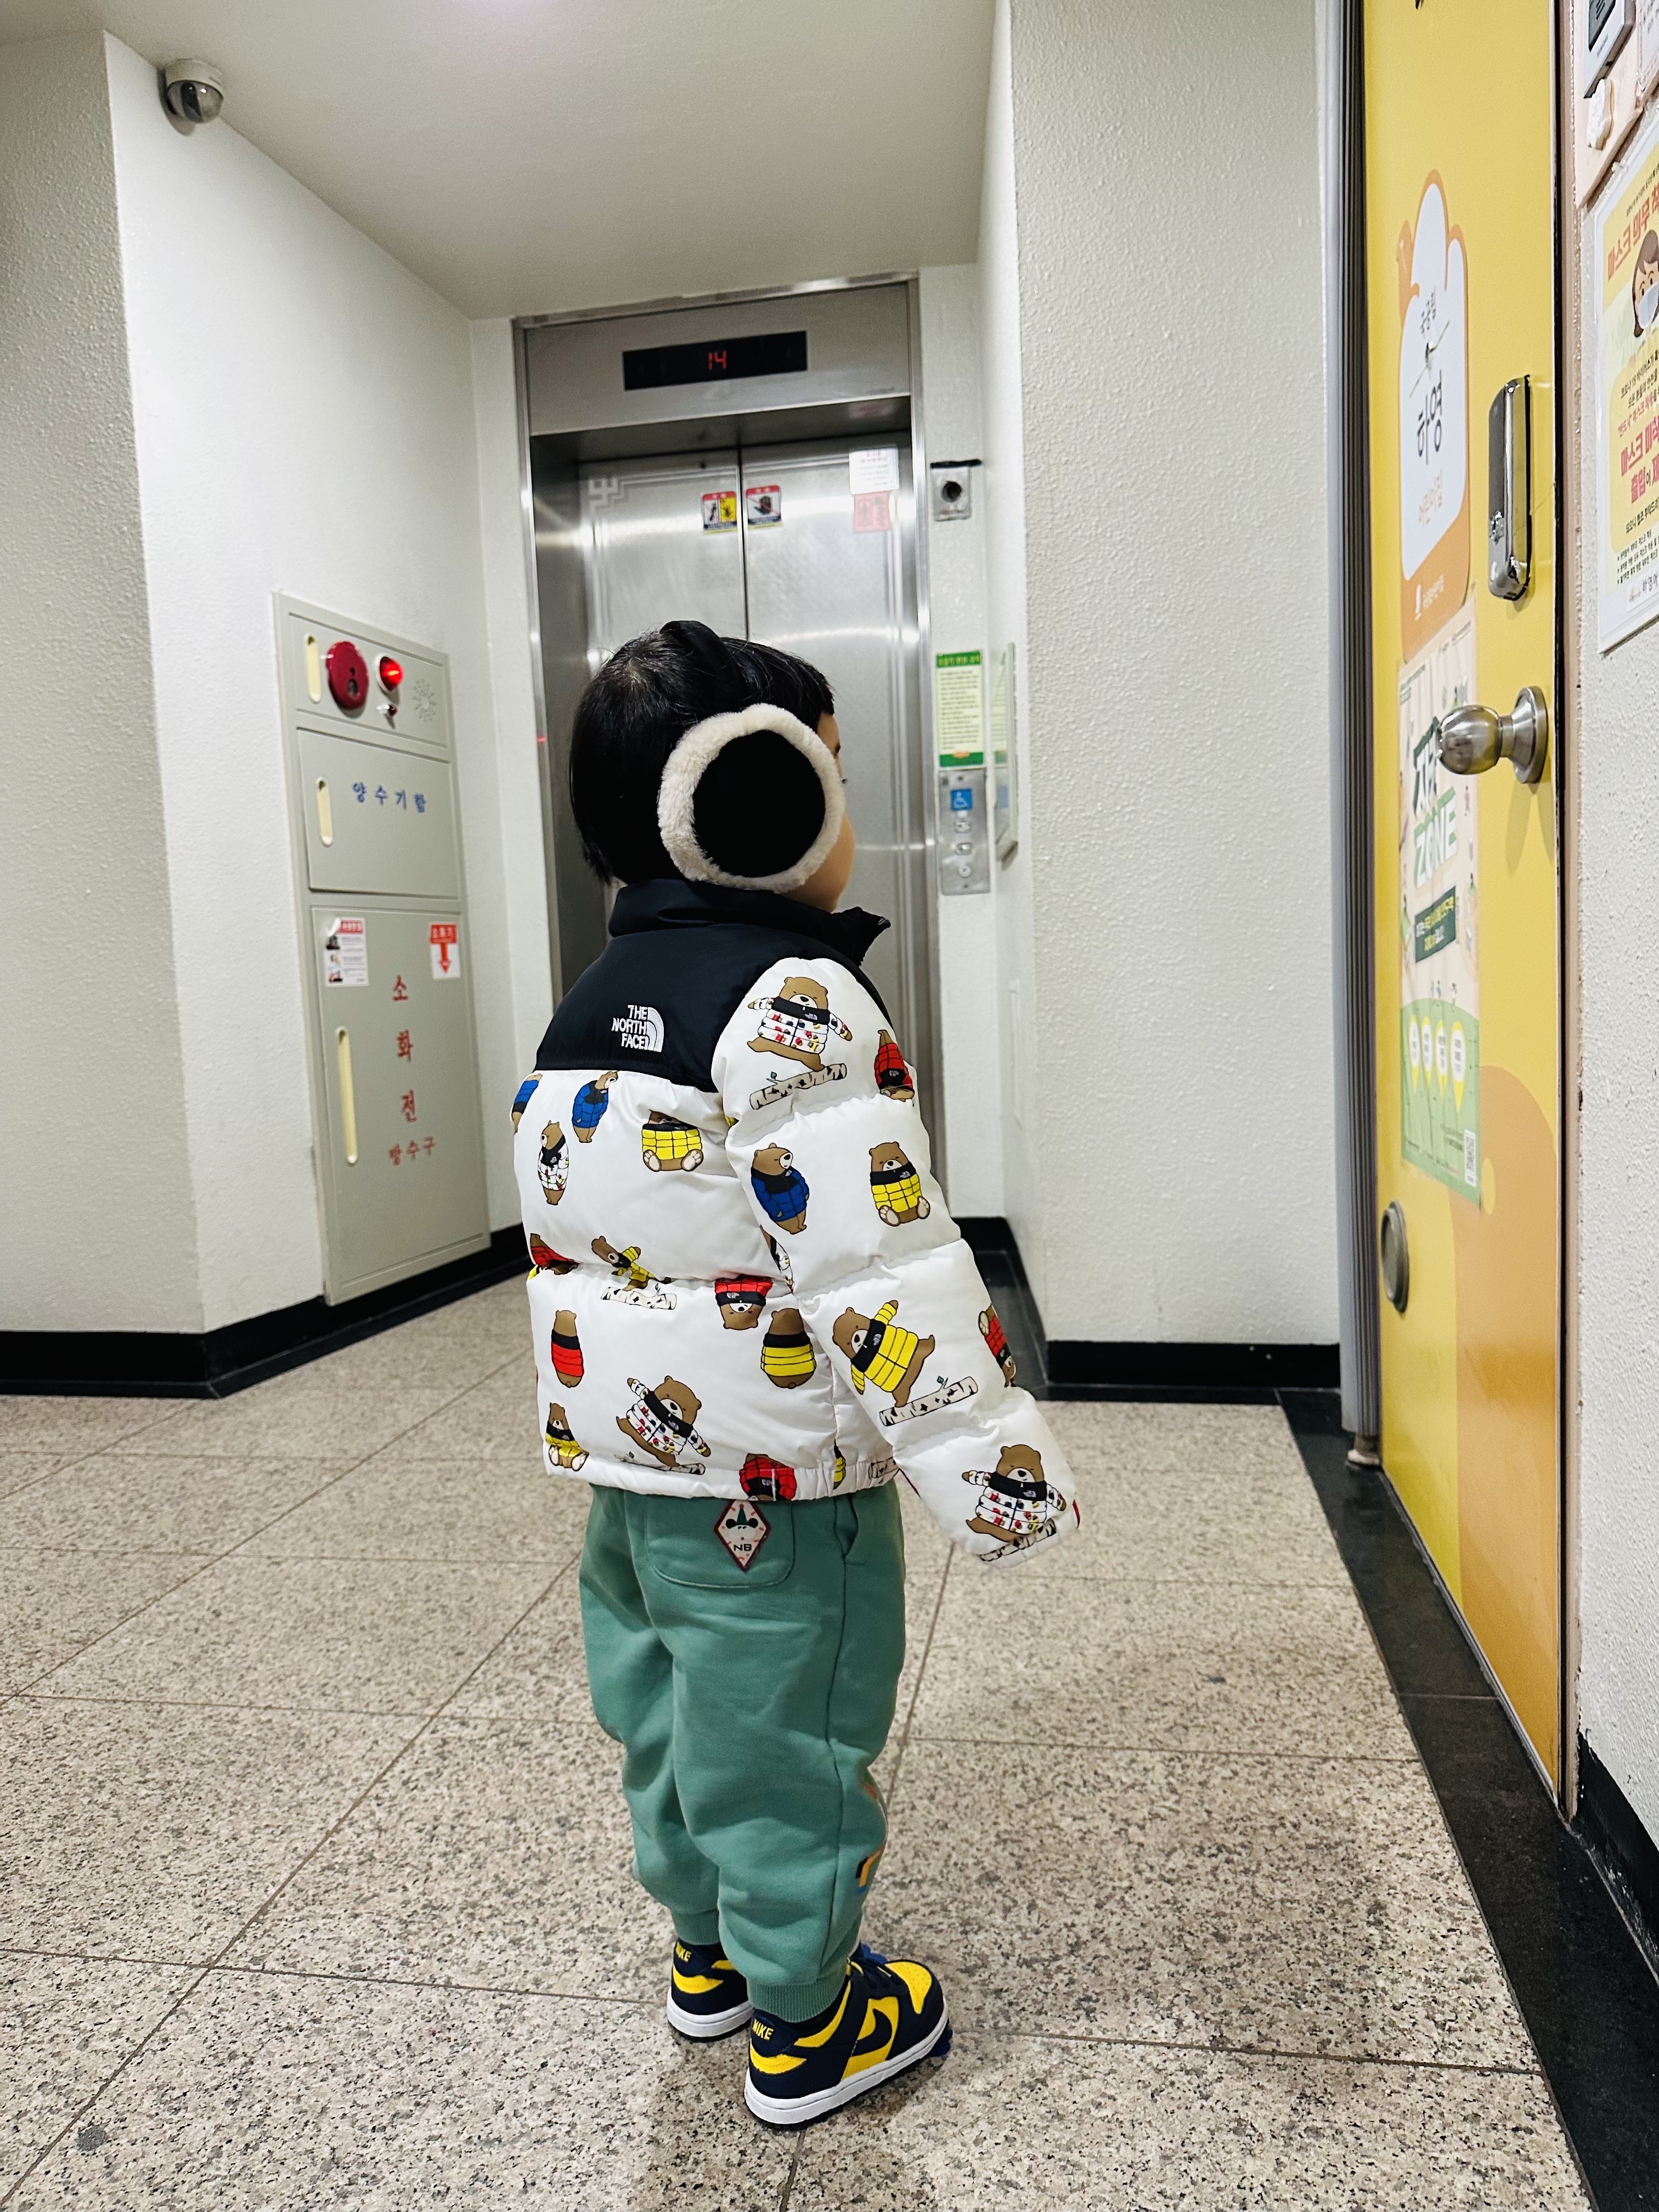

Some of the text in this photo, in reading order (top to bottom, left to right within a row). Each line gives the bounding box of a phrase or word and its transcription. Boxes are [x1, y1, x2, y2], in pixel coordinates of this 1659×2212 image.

[1608, 223, 1631, 281] 마스크
[708, 351, 727, 370] 14
[1417, 368, 1442, 466] 하영
[1621, 431, 1643, 477] 마스크
[352, 781, 426, 813] 양수기함
[1414, 787, 1457, 888] ZONE
[611, 1017, 647, 1035] NORTH
[628, 1005, 648, 1020] THE
[621, 1032, 645, 1049] FACE
[388, 1136, 436, 1166] 방수구
[752, 2019, 774, 2041] NIKE
